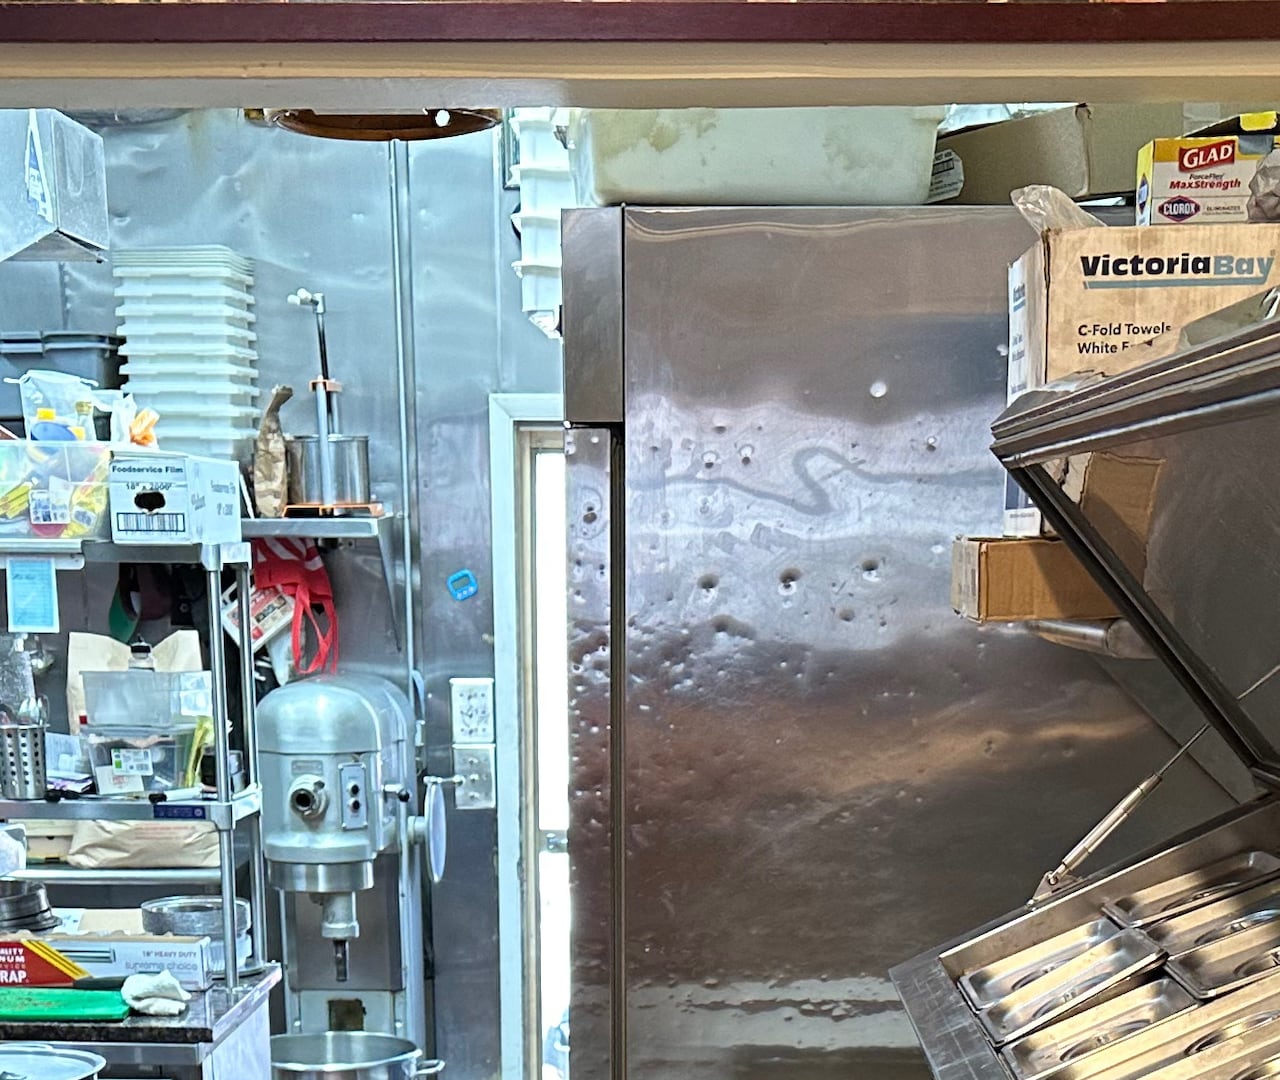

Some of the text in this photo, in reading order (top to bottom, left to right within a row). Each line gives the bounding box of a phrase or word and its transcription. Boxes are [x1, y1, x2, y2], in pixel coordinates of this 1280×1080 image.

[1182, 144, 1233, 169] GLAD
[1169, 178, 1241, 191] MaxStrength
[1163, 203, 1196, 215] CLOROX
[1080, 253, 1275, 283] VictoriaBay
[1078, 323, 1121, 336] C-Fold
[1078, 342, 1118, 354] White
[112, 465, 184, 473] Foodservice Film
